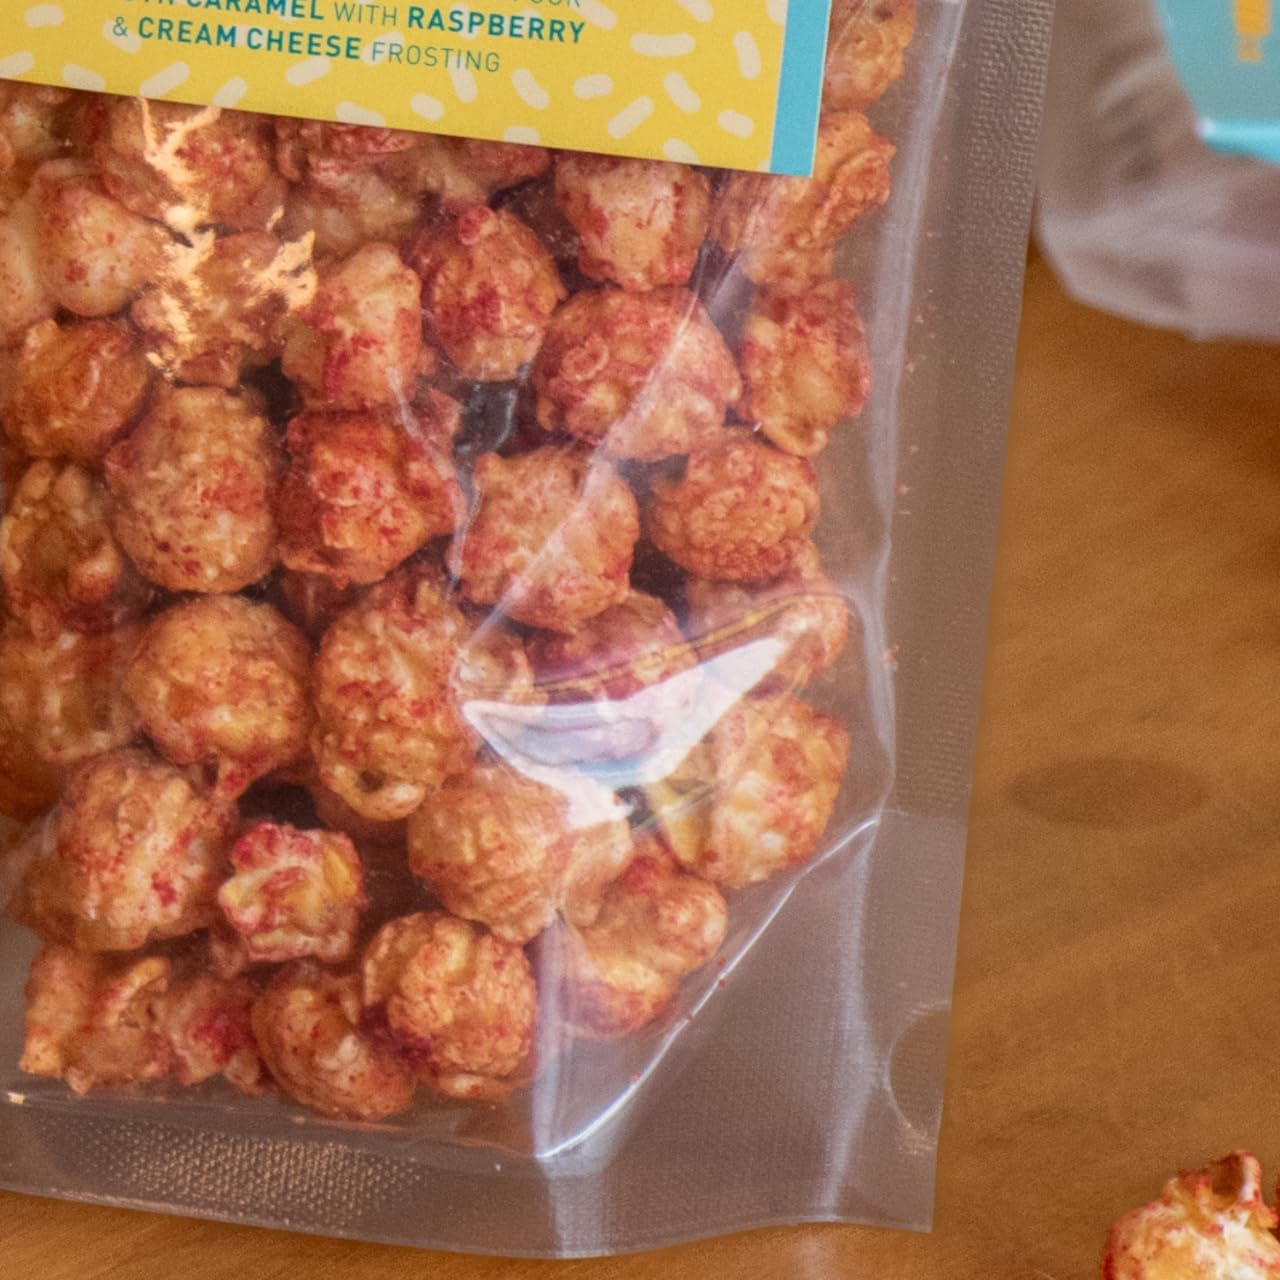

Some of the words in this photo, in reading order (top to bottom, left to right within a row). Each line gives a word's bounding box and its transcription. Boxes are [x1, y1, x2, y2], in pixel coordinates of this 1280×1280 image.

[112, 17, 128, 36] &
[138, 17, 236, 47] CREAM
[247, 29, 360, 60] CHEESE
[371, 42, 501, 72] FROSTING
[333, 2, 398, 26] WITH
[407, 7, 585, 43] RASPBERRY
